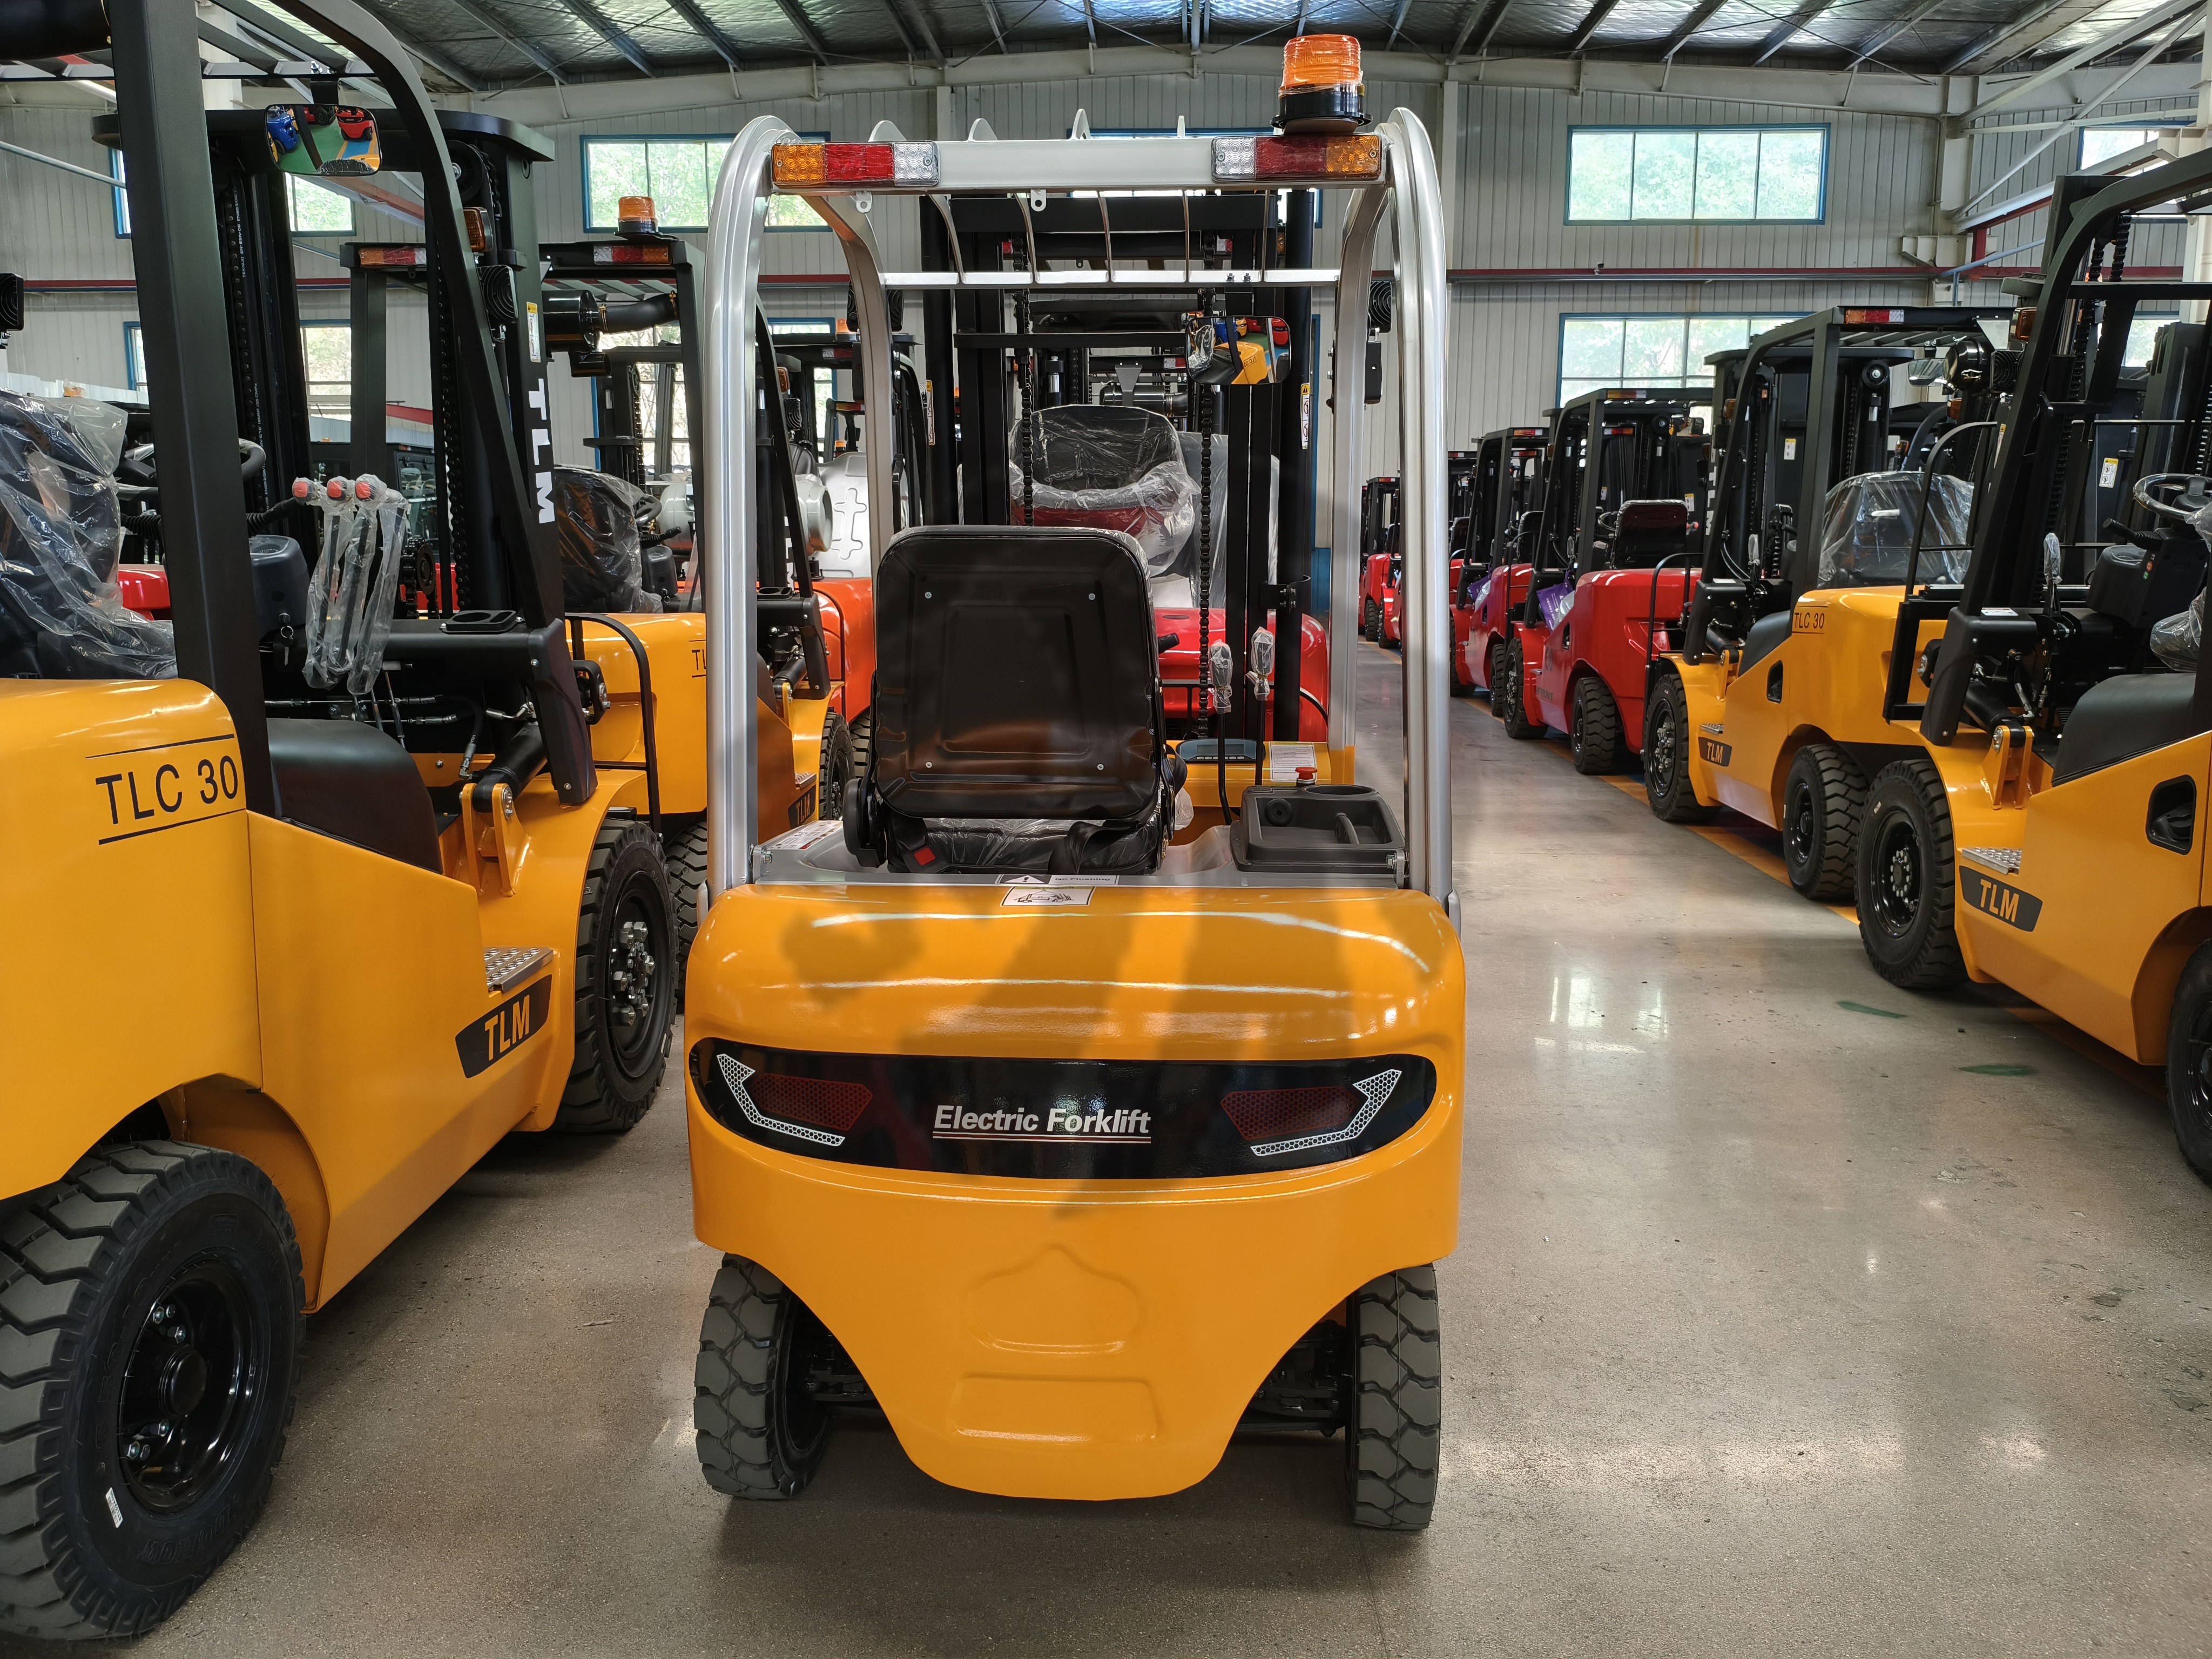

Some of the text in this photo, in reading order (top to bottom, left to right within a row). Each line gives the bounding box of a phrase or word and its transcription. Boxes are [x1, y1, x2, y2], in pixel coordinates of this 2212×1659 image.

[529, 379, 555, 524] TLM
[1705, 466, 1717, 535] TLM
[1794, 612, 1825, 629] TLC 30
[1707, 741, 1723, 763] TLM
[95, 755, 238, 824] TLC 30
[796, 793, 810, 825] TLM
[1980, 878, 2019, 922] TLM
[484, 994, 530, 1061] TLM
[934, 1105, 1151, 1133] Electric Forklift
